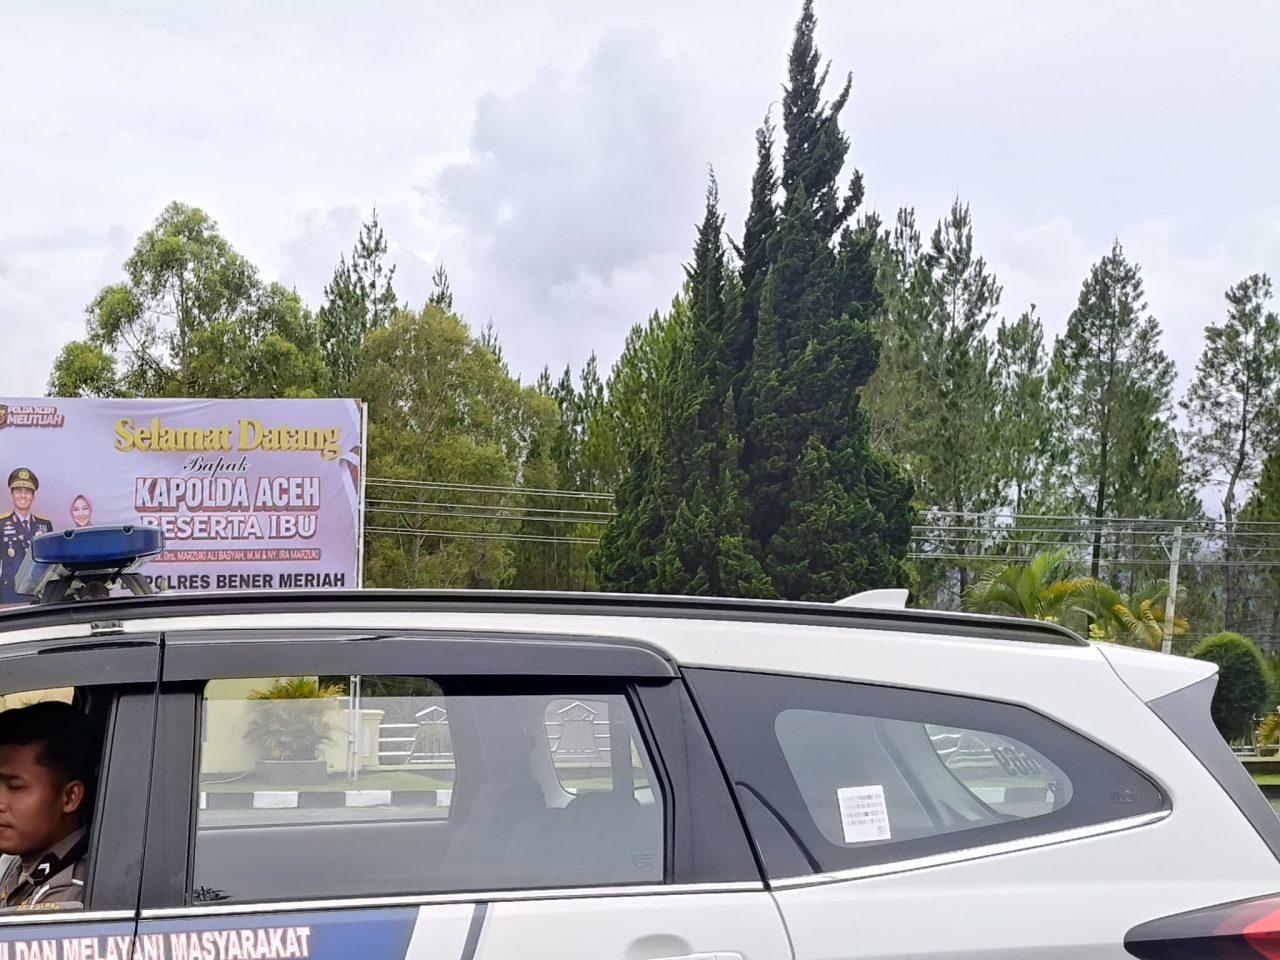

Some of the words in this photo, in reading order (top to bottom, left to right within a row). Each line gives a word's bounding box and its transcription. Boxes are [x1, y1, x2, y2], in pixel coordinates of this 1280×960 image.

[7, 414, 65, 428] MEUTUAH
[114, 416, 233, 452] Selamat
[237, 417, 342, 461] Datang
[183, 455, 249, 478] Bapak
[135, 477, 250, 512] KAPOLDA
[253, 477, 320, 512] ACEH
[269, 514, 317, 539] IBU
[207, 550, 218, 560] ALI
[216, 574, 274, 589] BENER
[279, 572, 345, 588] MERIAH
